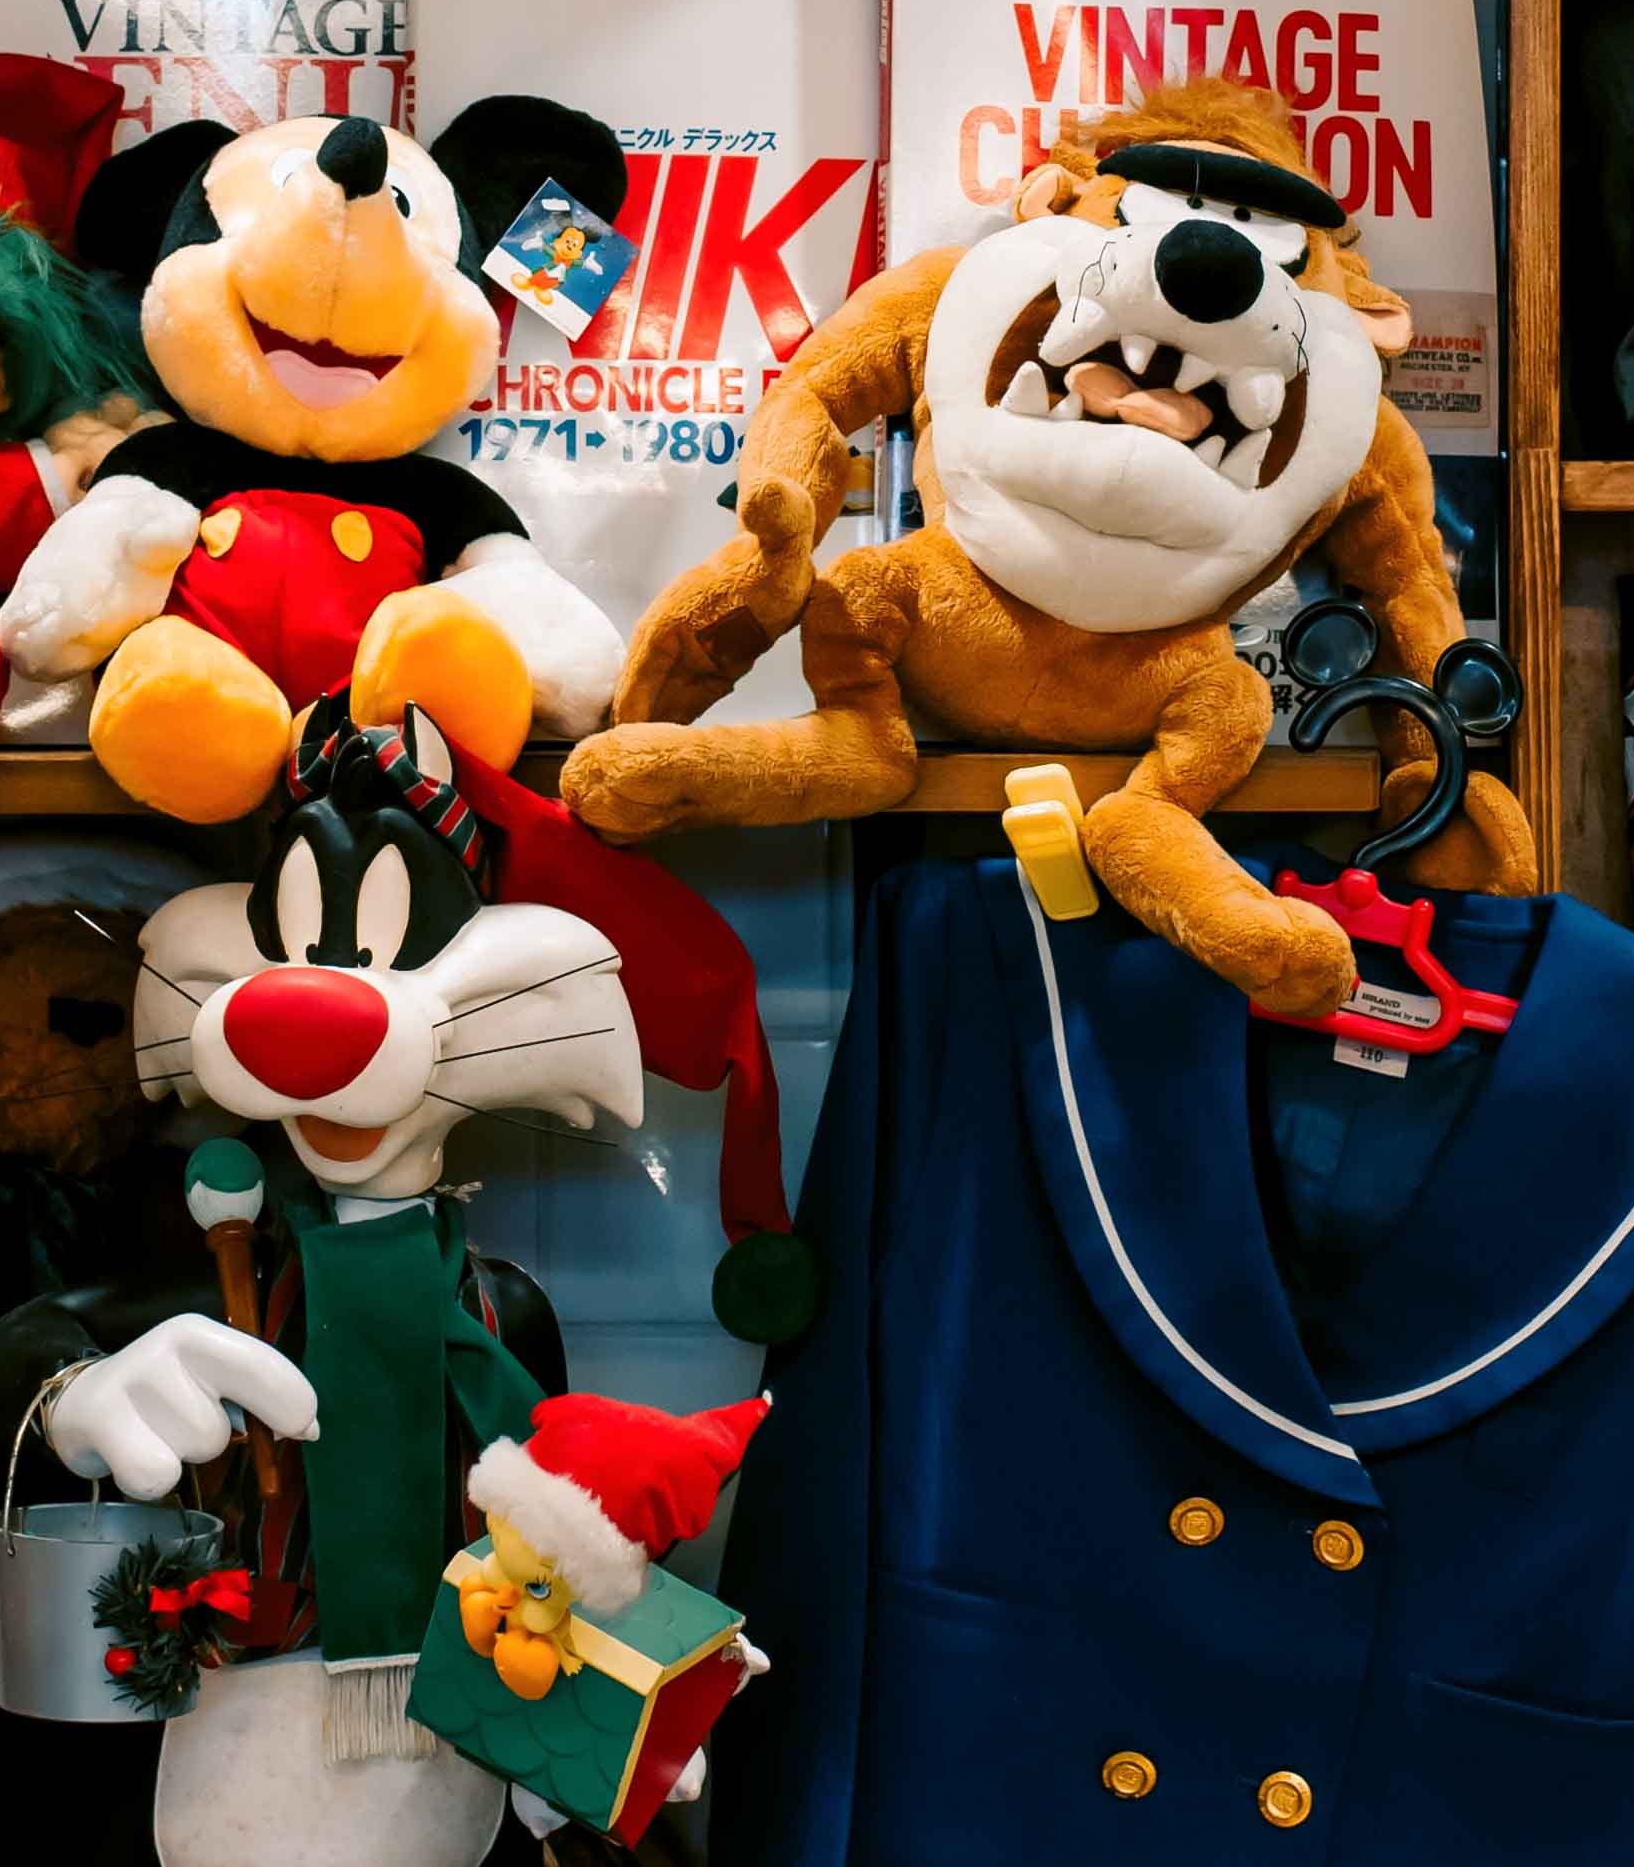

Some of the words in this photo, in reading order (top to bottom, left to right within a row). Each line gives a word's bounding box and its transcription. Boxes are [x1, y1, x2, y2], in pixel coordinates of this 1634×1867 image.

[682, 127, 777, 152] デラックス
